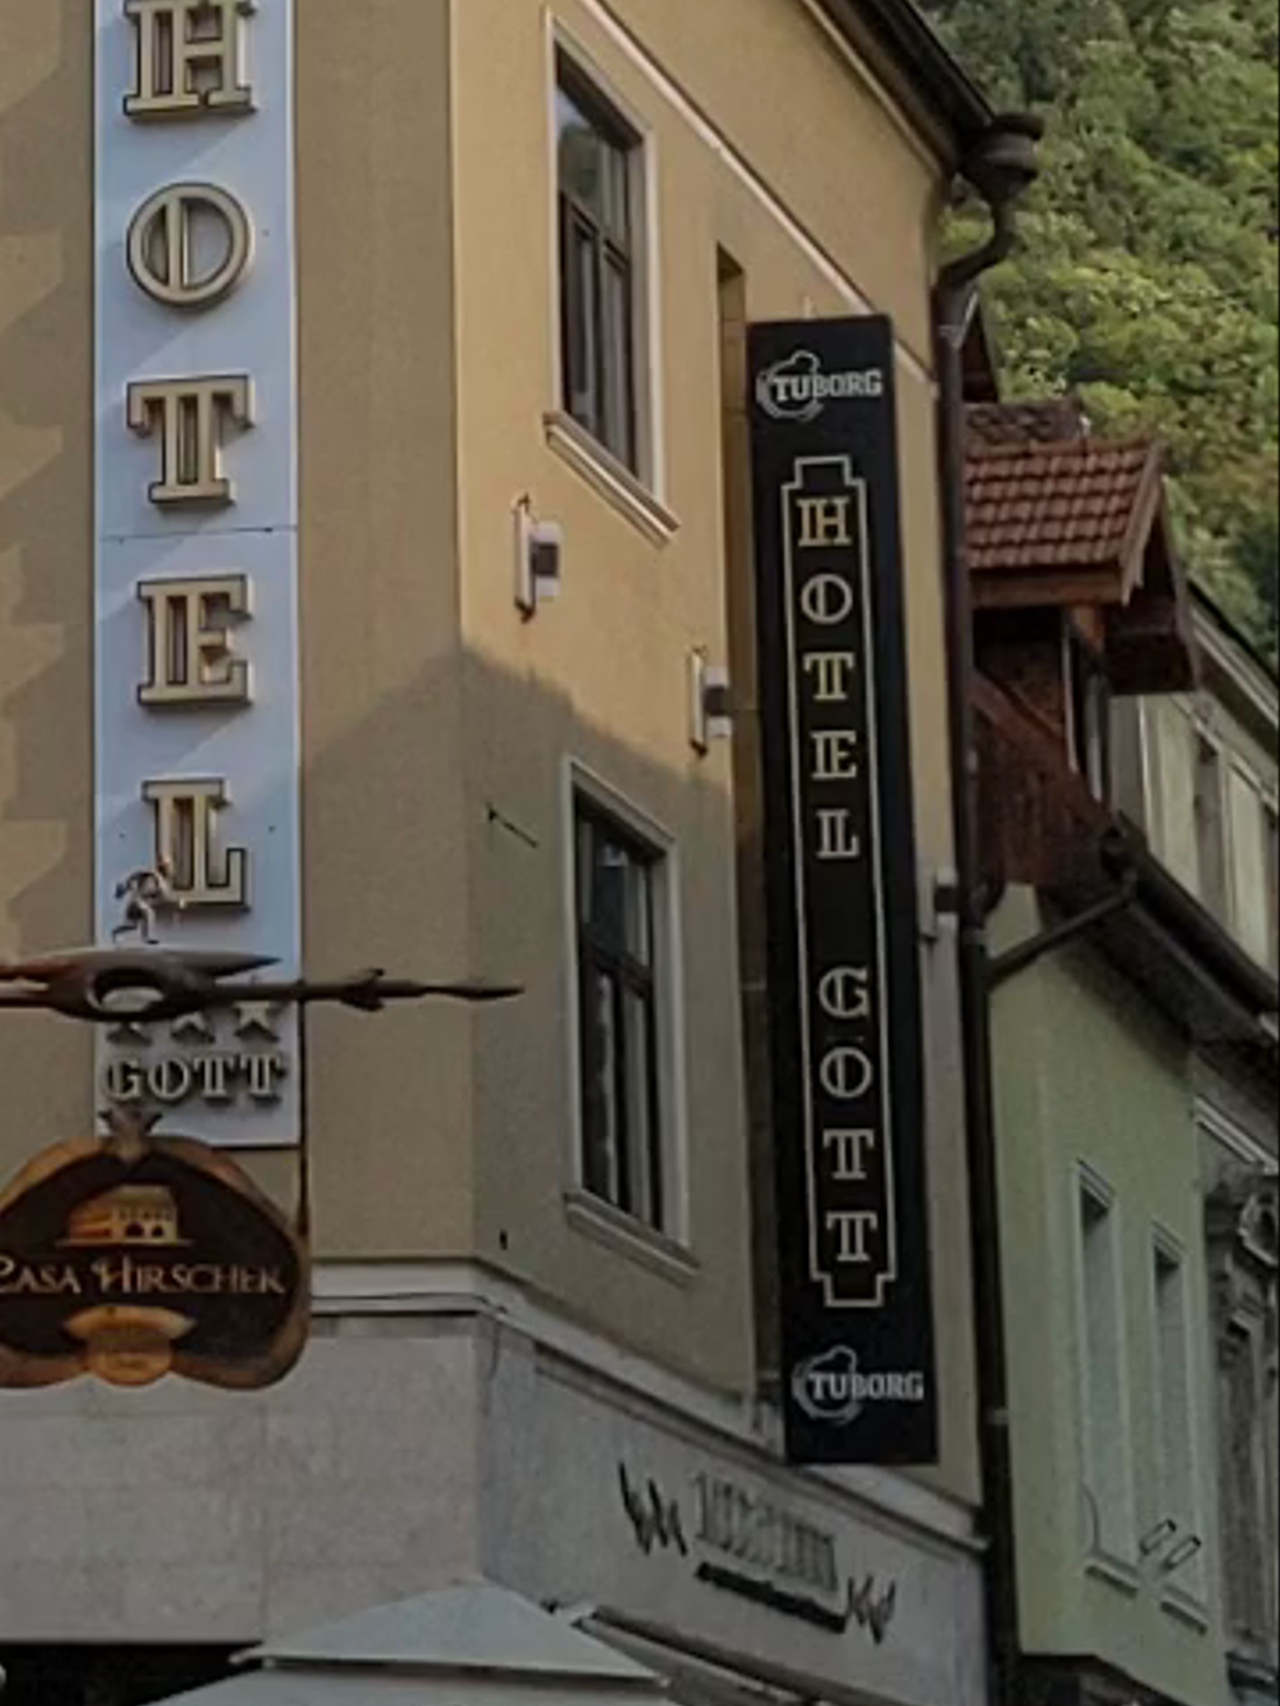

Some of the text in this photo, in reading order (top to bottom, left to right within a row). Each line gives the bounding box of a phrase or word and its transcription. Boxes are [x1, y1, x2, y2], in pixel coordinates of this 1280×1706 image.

[772, 368, 884, 404] TUBORG
[794, 494, 880, 1264] HOTEL GOTT
[104, 1053, 286, 1105] GOTT
[807, 1370, 926, 1401] TUBORG
